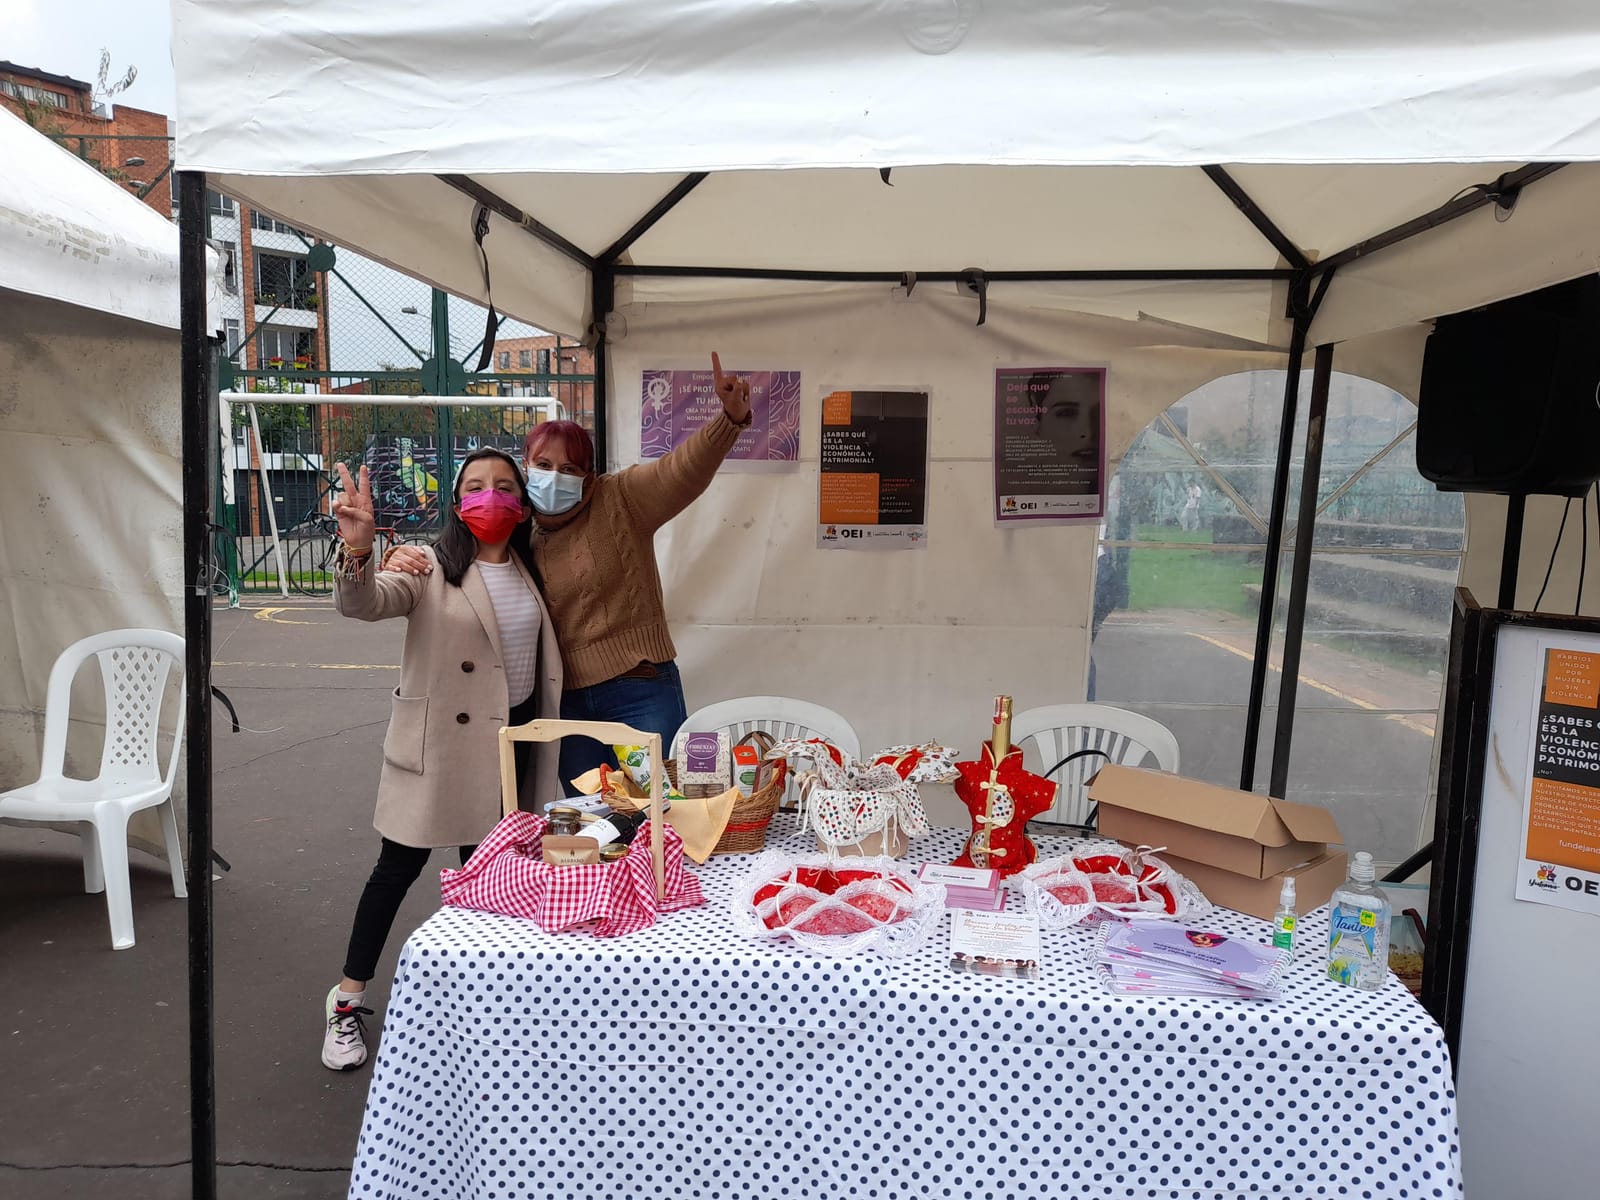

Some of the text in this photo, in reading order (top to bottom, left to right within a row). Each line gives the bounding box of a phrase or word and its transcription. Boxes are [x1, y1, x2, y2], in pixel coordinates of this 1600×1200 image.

[1007, 384, 1050, 392] Deja que
[1006, 406, 1048, 414] escuche
[841, 530, 863, 538] OEI
[1555, 676, 1591, 685] MUJERES
[1551, 690, 1592, 700] VIOLENCIA
[1542, 714, 1592, 728] ¿SABES
[1542, 724, 1578, 736] ES LA
[1541, 734, 1600, 750] VIOLENC
[1539, 754, 1600, 771] PATRIMO
[1536, 789, 1565, 797] NUESTRO
[1546, 784, 1580, 793] INVITAMOS
[1536, 795, 1566, 804] CONOCER
[1534, 808, 1575, 819] DESARROLLA
[1550, 817, 1576, 826] NEGOCIO
